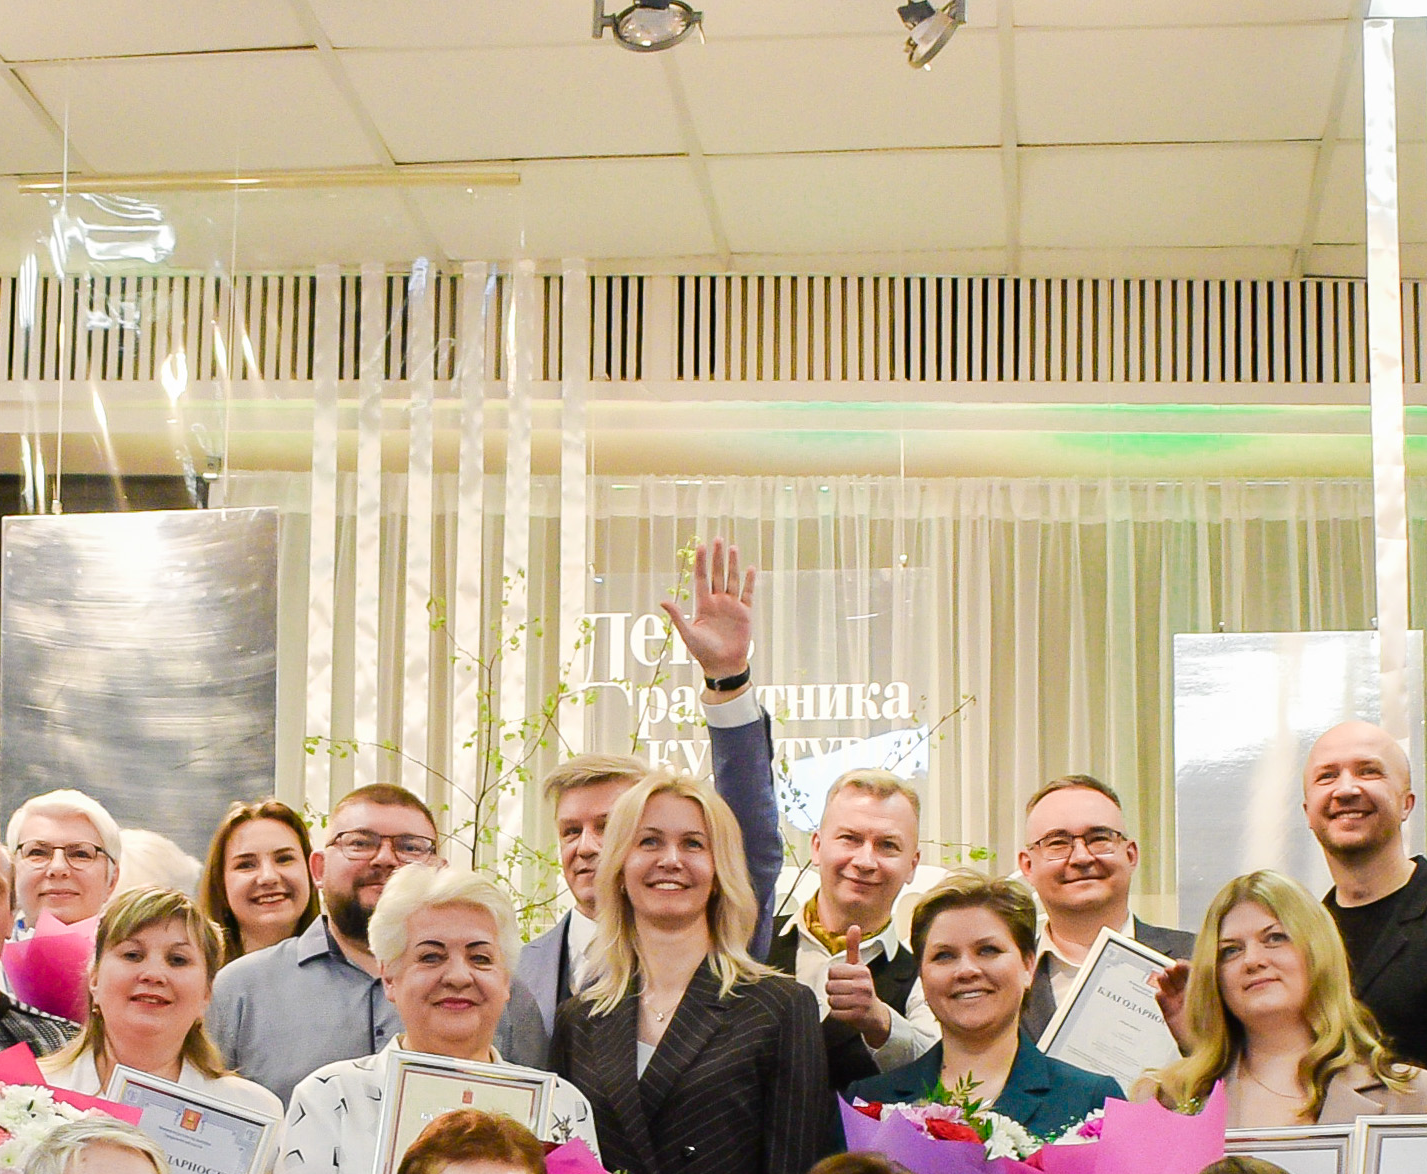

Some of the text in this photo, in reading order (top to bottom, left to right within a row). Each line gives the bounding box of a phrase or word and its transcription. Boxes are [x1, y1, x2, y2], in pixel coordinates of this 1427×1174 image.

[575, 611, 755, 707] Де
[638, 681, 914, 739] ратника
[1097, 986, 1166, 1026] БЛАГОДАРНО
